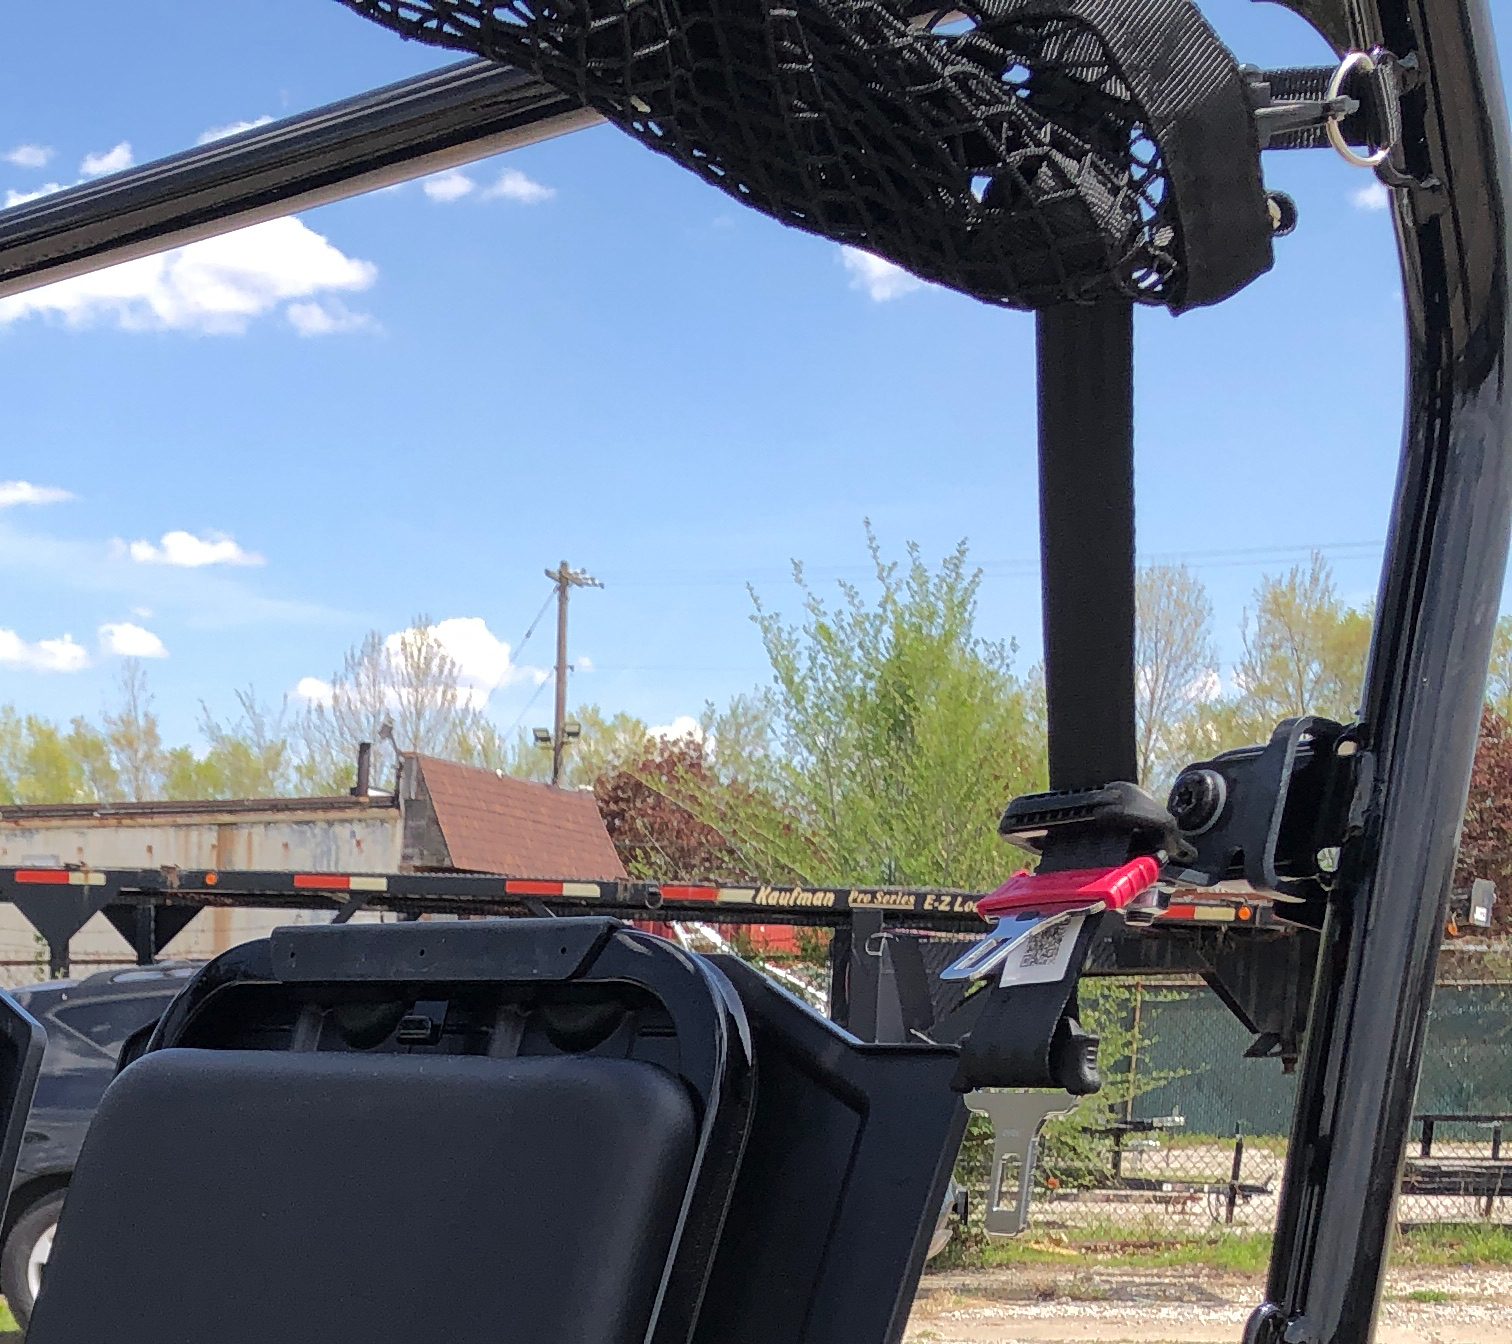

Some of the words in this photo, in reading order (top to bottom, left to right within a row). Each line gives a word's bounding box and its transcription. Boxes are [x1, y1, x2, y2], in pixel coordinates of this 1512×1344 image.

[755, 885, 835, 907] Kaufman
[848, 890, 870, 905] Pro
[875, 891, 915, 906] Series
[923, 894, 952, 912] E-Z
